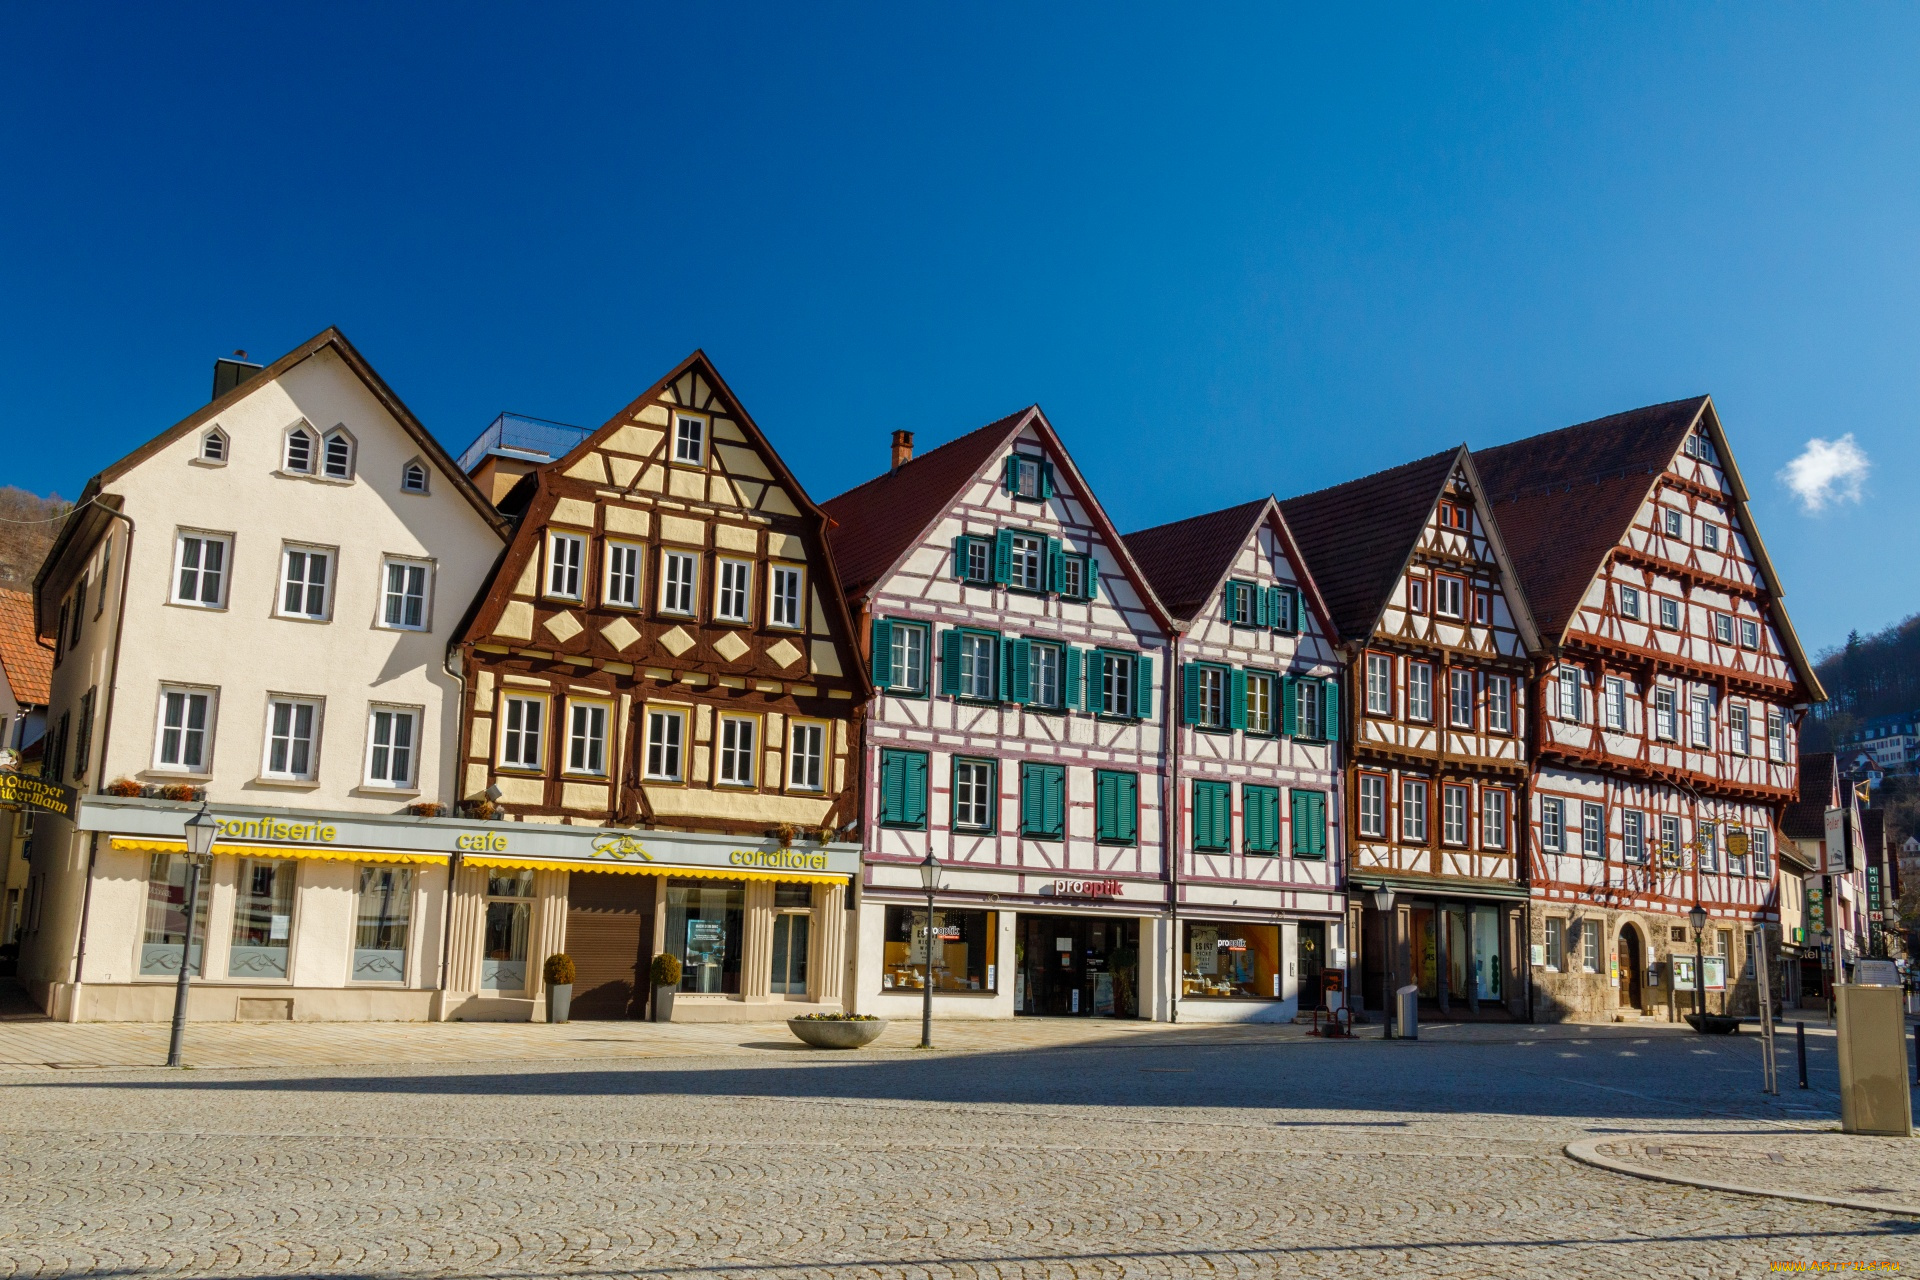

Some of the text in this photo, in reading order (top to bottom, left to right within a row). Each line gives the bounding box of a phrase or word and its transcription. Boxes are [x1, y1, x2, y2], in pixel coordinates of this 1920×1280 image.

[6, 776, 64, 797] Quenzer
[216, 816, 337, 842] confiserie
[730, 847, 829, 869] conditorei
[1053, 879, 1123, 898] prooptik
[1869, 868, 1878, 910] HOTEL
[924, 926, 960, 935] pooptik
